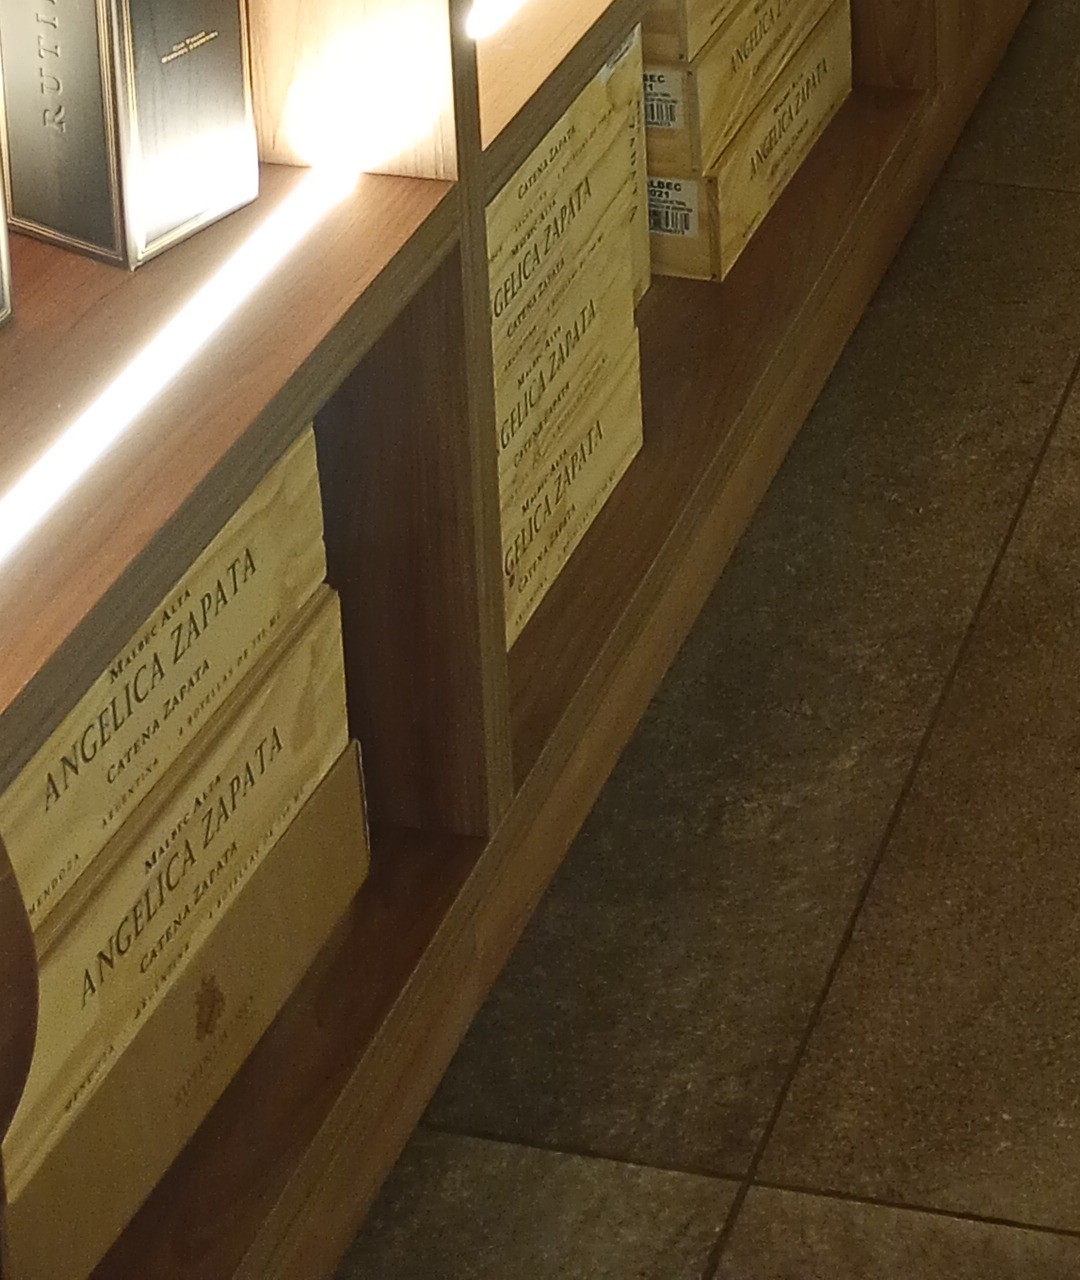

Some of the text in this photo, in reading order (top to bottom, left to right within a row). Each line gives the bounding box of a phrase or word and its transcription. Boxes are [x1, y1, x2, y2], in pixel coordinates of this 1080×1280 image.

[493, 243, 541, 318] GELICA
[543, 176, 592, 256] ZAPATA
[649, 179, 682, 192] LBEC
[649, 188, 670, 199] 021
[500, 369, 547, 450] GELICA
[549, 298, 596, 383] ZAPATA
[504, 494, 552, 577] GELICA
[554, 419, 603, 506] ZAPATA
[44, 547, 257, 812] ANGELICA ZAPATA
[108, 588, 192, 685] MALBEC ALTA
[106, 659, 210, 785] CATENA ZAPATA
[80, 837, 198, 1009] ANGELICA
[199, 724, 285, 850] ZAPATA
[143, 774, 222, 875] MALBEC ALTA
[138, 840, 239, 975] CATENA ZAPATA
